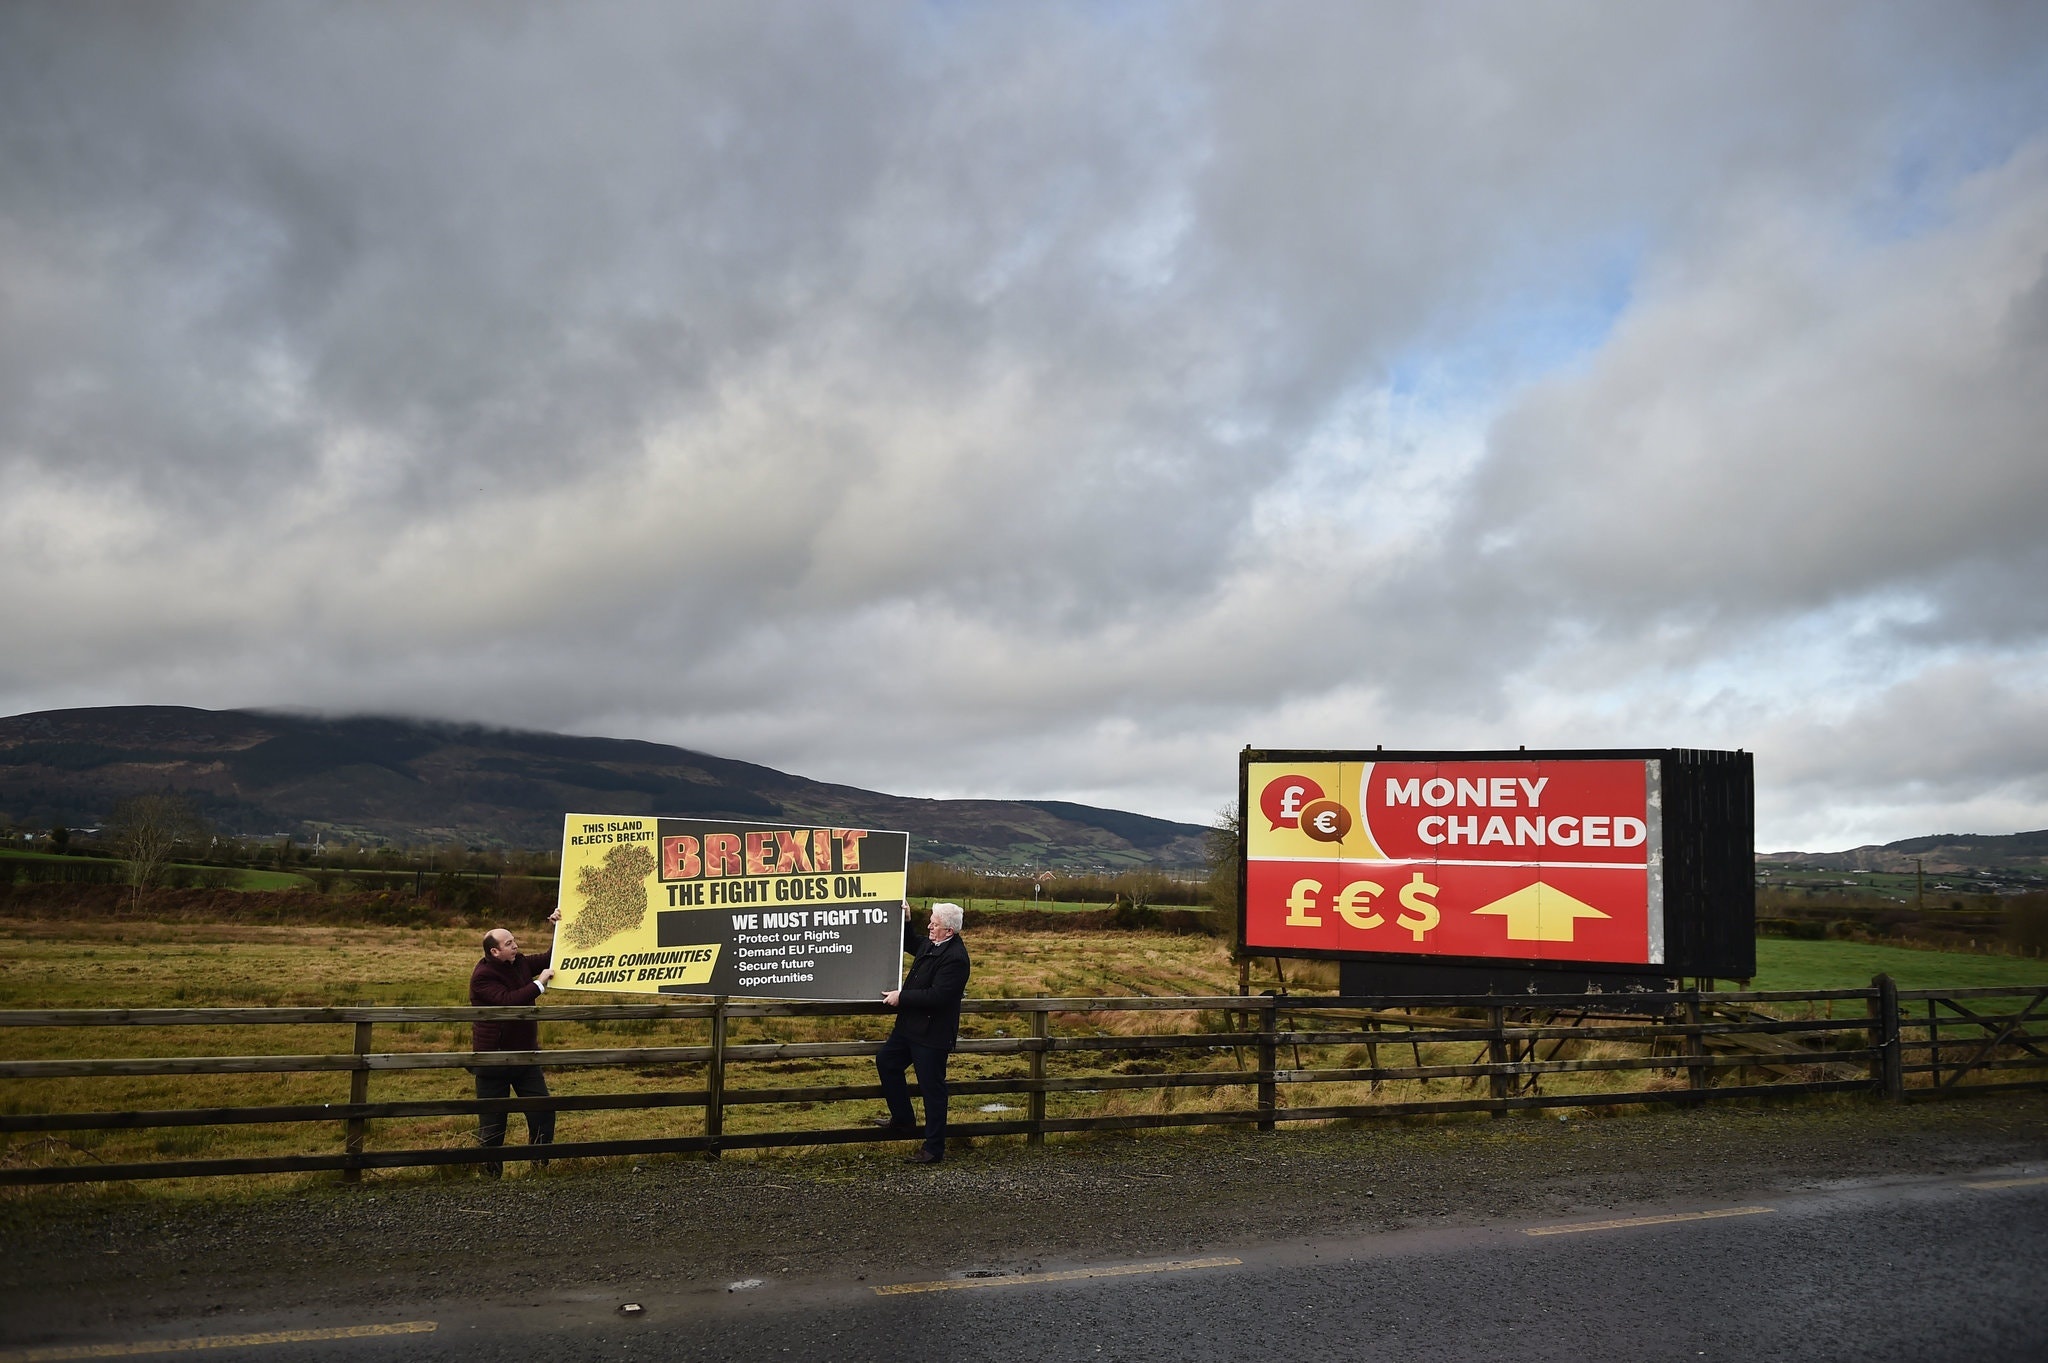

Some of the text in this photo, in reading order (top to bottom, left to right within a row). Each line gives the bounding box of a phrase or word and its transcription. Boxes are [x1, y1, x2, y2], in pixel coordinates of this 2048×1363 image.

[1385, 777, 1549, 807] MONEY
[583, 821, 642, 833] THIS ISLAND
[1417, 816, 1647, 847] CHANGED
[571, 832, 654, 845] REJECTS BREXIT!
[662, 829, 867, 880] BREXIT
[666, 876, 876, 906] THE FIGHT GOES ON...
[732, 908, 888, 930] WE MUST FIGHT TO:
[738, 930, 840, 944] Protect our Rights
[560, 949, 712, 970] BORDER COMMUNITIES
[739, 943, 852, 958] Demand EU Funding
[739, 959, 814, 972] Secure future
[576, 966, 686, 985] AGAINST BREXIT
[739, 972, 813, 987] opportunities
